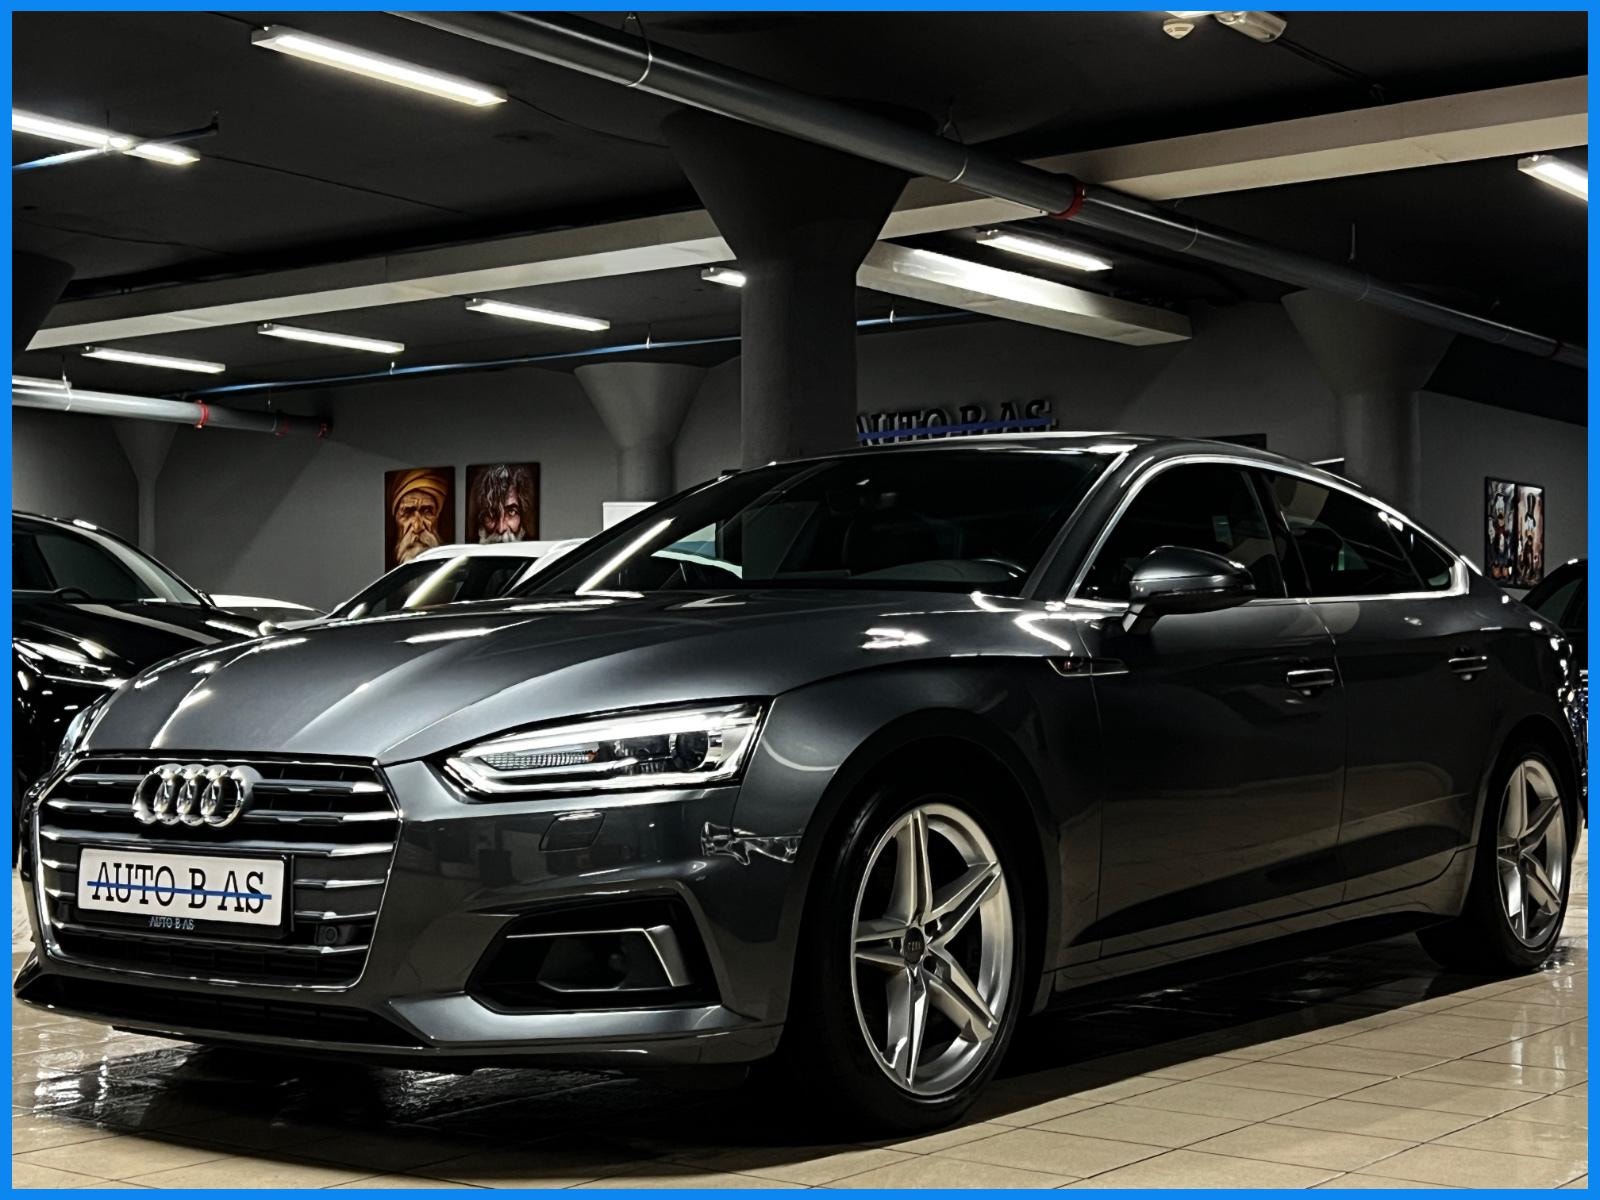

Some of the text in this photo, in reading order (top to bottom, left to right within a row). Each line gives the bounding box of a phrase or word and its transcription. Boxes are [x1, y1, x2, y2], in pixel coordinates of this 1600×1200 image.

[92, 862, 264, 914] AUTO B AS
[150, 916, 173, 928] AUTO
[182, 919, 195, 931] AS
